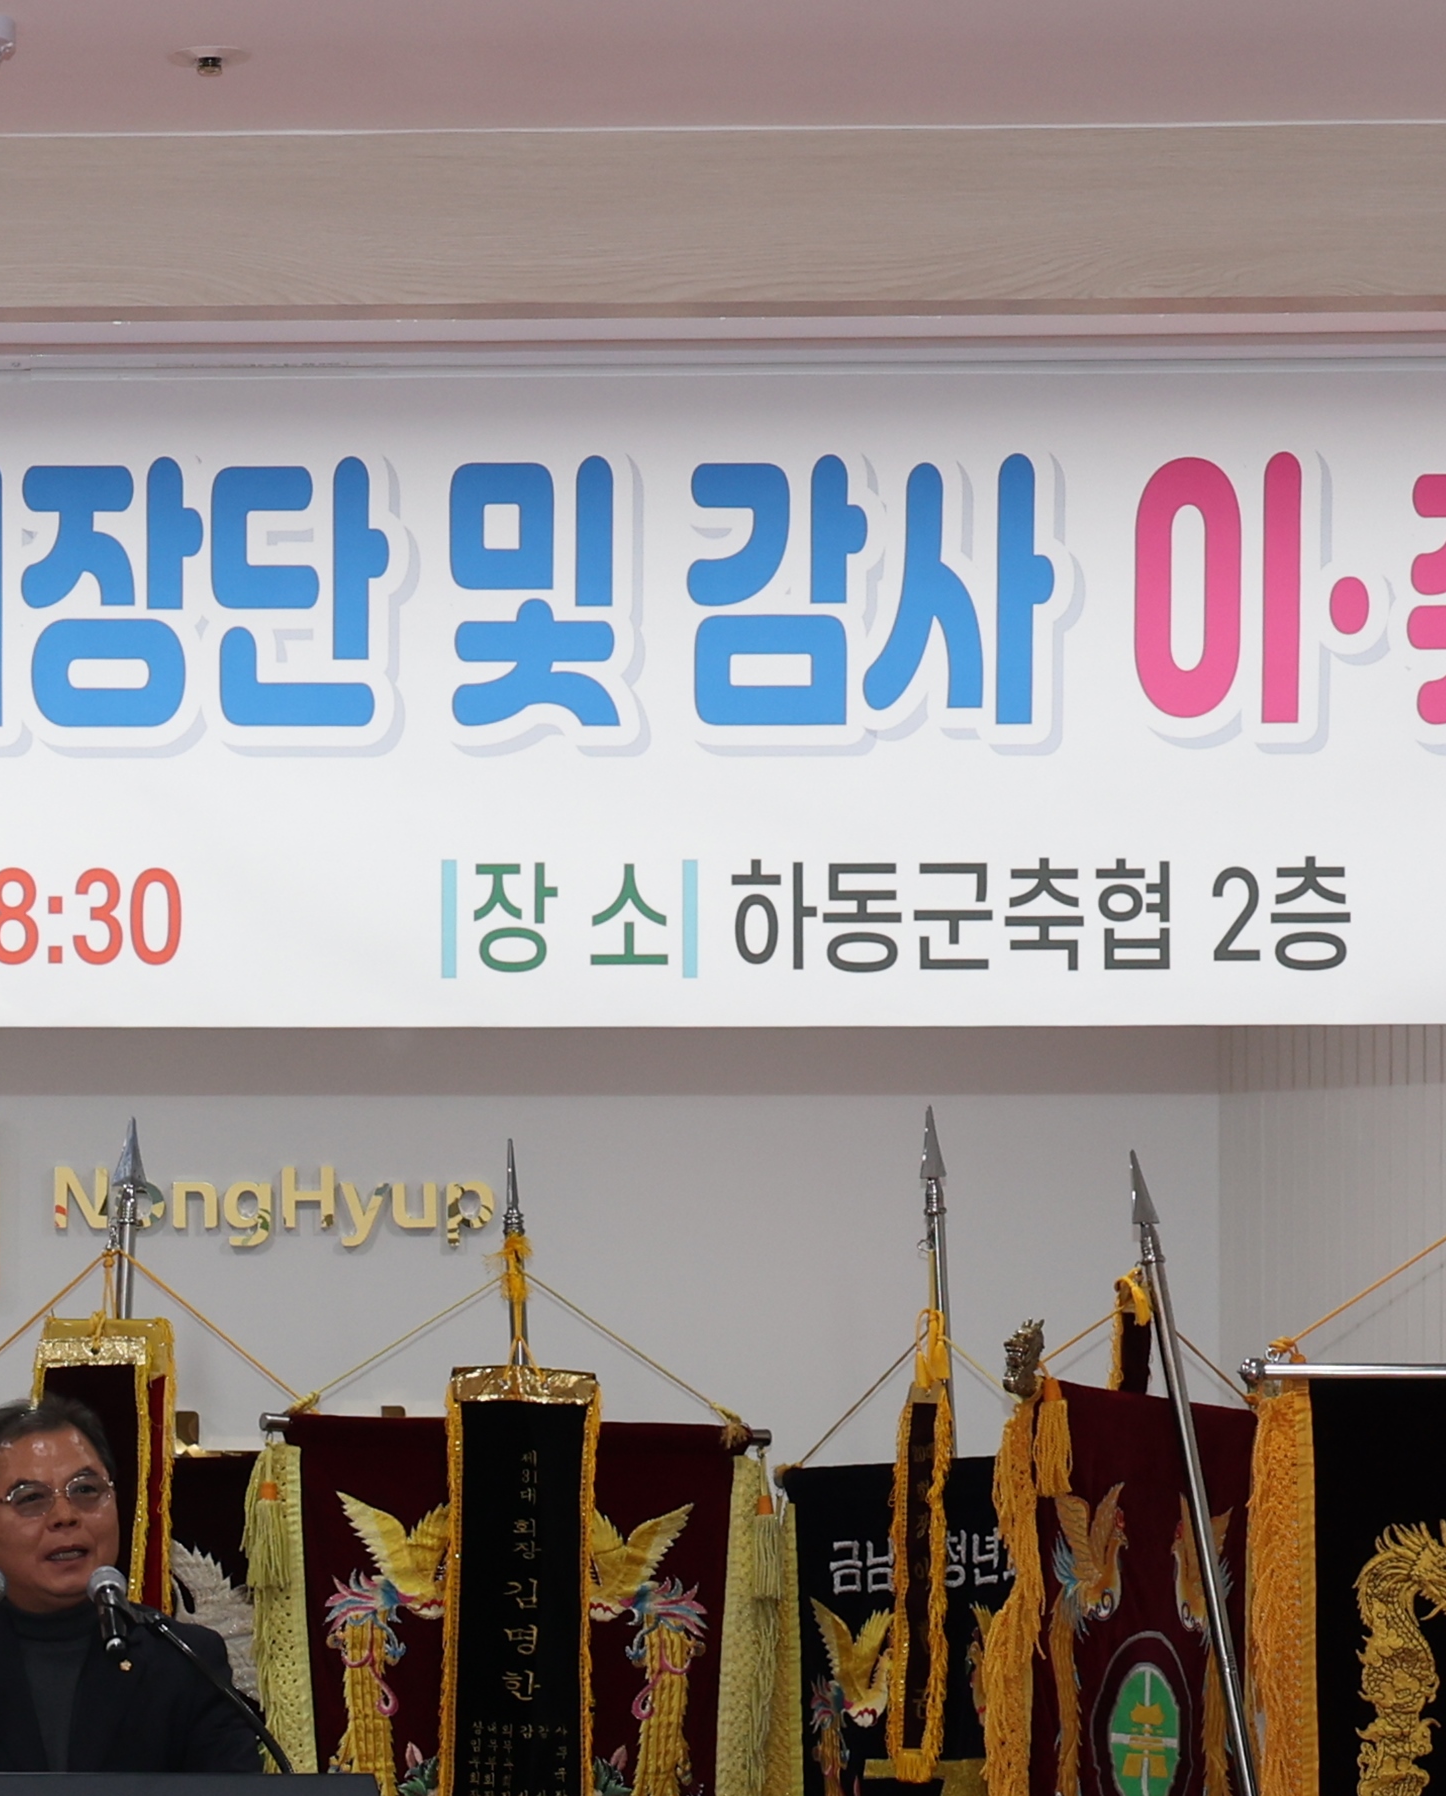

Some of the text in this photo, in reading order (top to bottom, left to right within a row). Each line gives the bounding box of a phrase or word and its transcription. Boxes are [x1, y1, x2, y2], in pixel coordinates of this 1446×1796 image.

[449, 456, 622, 729] 및
[688, 454, 1057, 728] 감사
[731, 857, 1172, 975] 하동군축협
[1211, 856, 1353, 973] 2층
[52, 1163, 496, 1249] NongHyup
[512, 1517, 542, 1560] 회장
